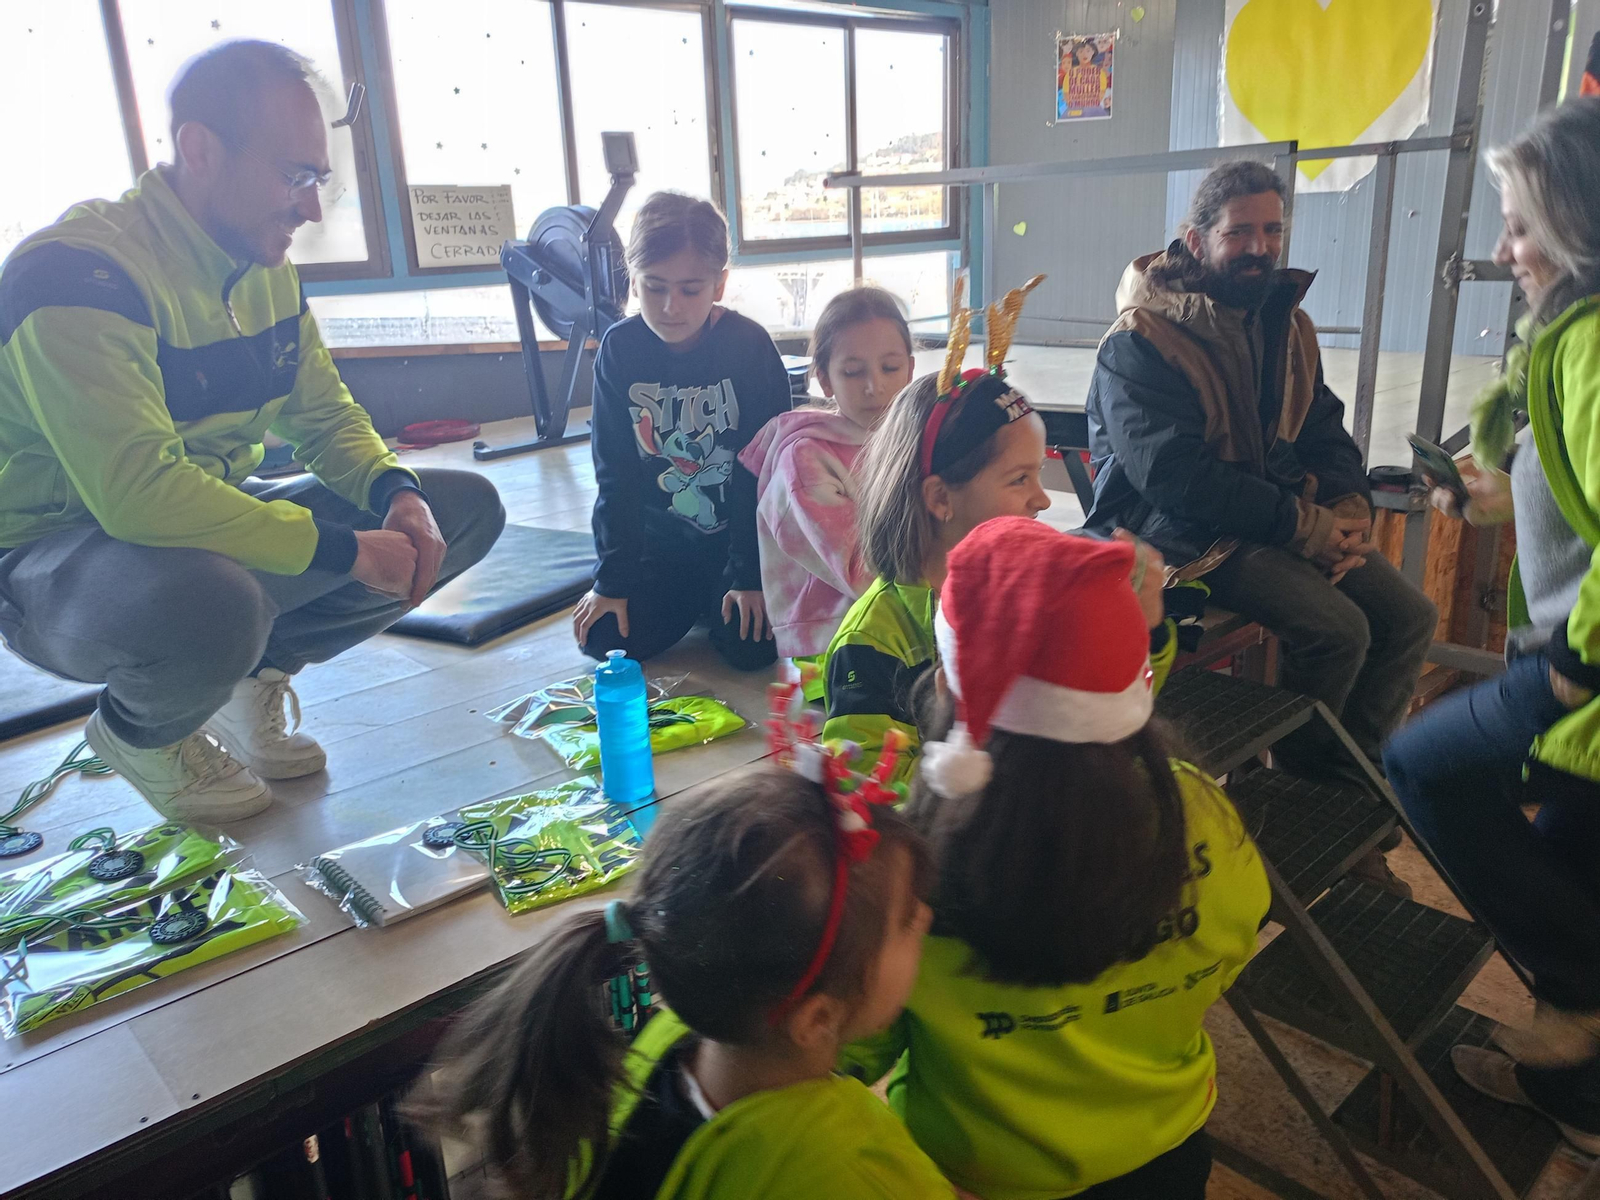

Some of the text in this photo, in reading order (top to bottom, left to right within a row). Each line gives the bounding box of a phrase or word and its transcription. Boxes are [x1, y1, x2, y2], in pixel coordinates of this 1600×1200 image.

[443, 190, 489, 204] FAVOR
[417, 211, 491, 222] DEJAR LAS
[424, 225, 499, 236] VENTANAS
